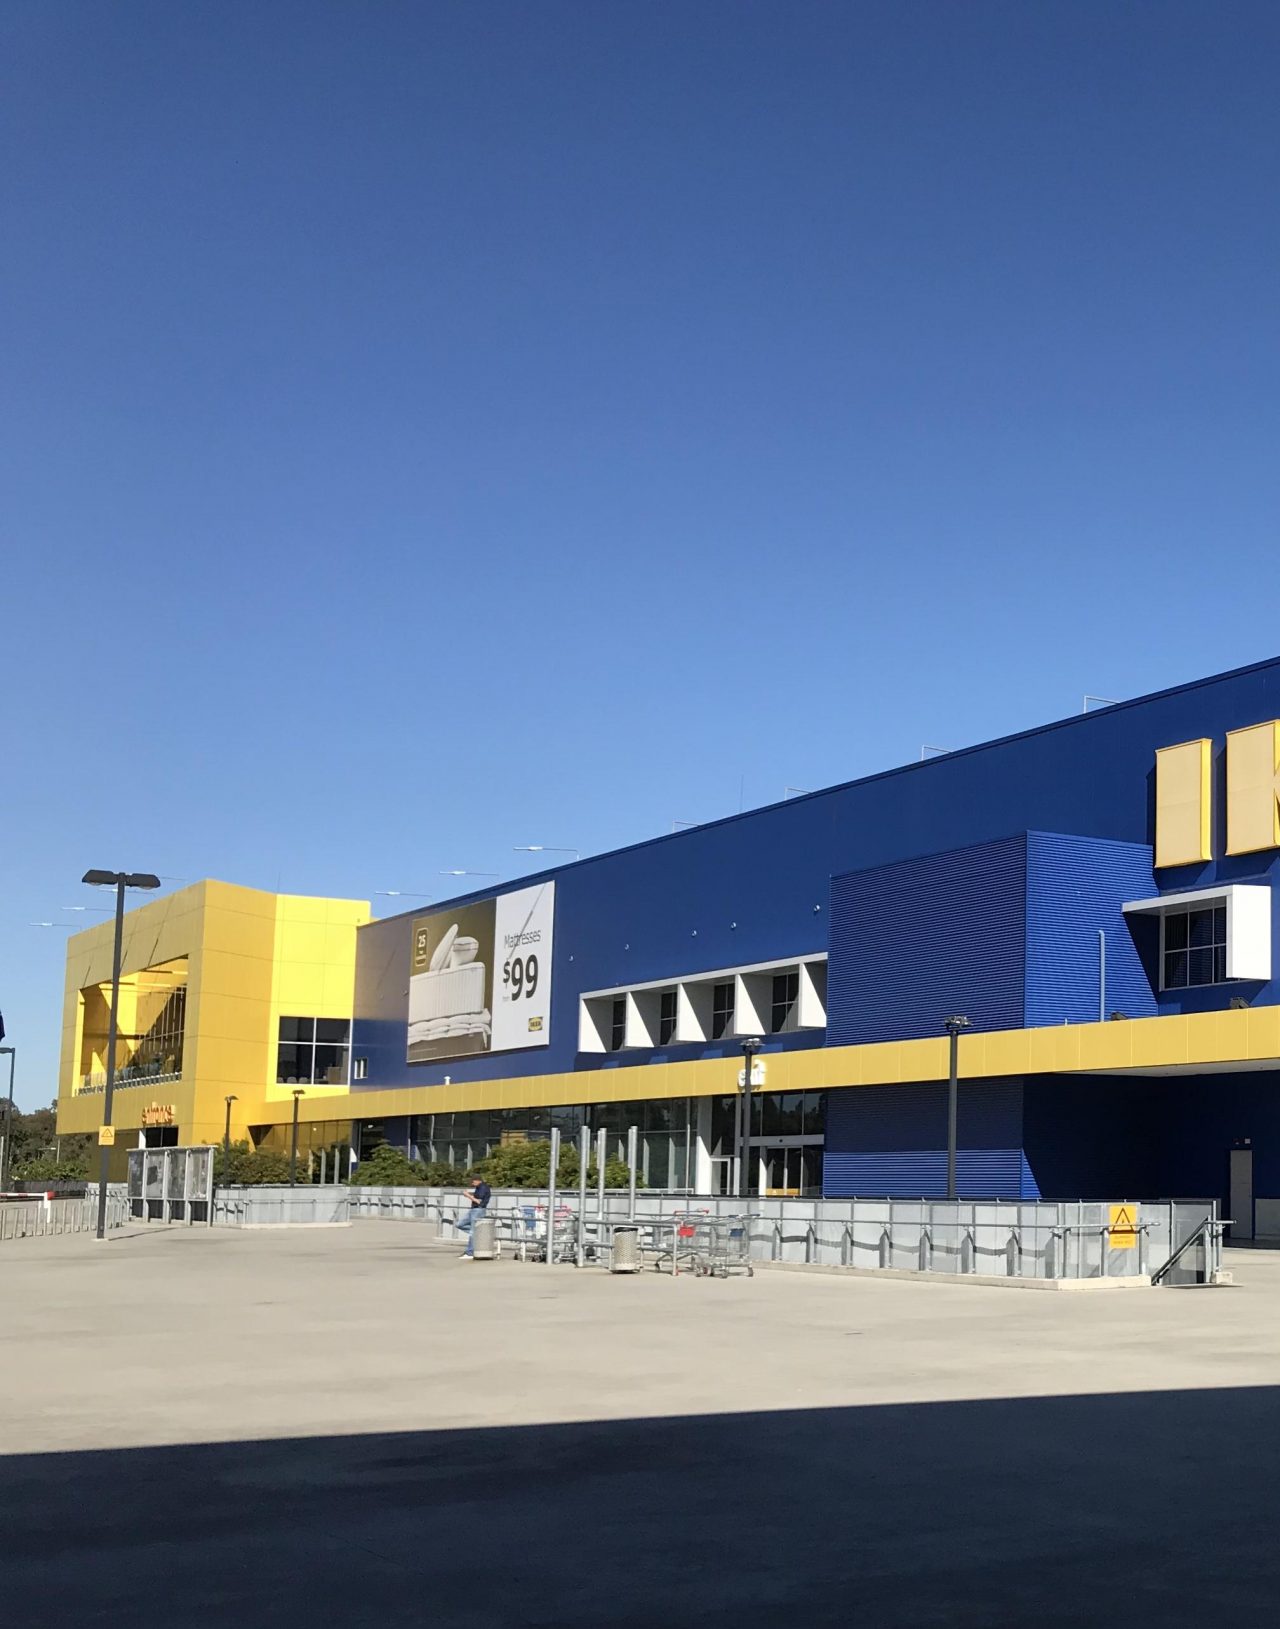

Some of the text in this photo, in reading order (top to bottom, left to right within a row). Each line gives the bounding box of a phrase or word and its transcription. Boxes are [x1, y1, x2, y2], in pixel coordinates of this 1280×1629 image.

[504, 929, 541, 949] Mattresses
[502, 954, 539, 1001] $99
[738, 1058, 767, 1087] eit
